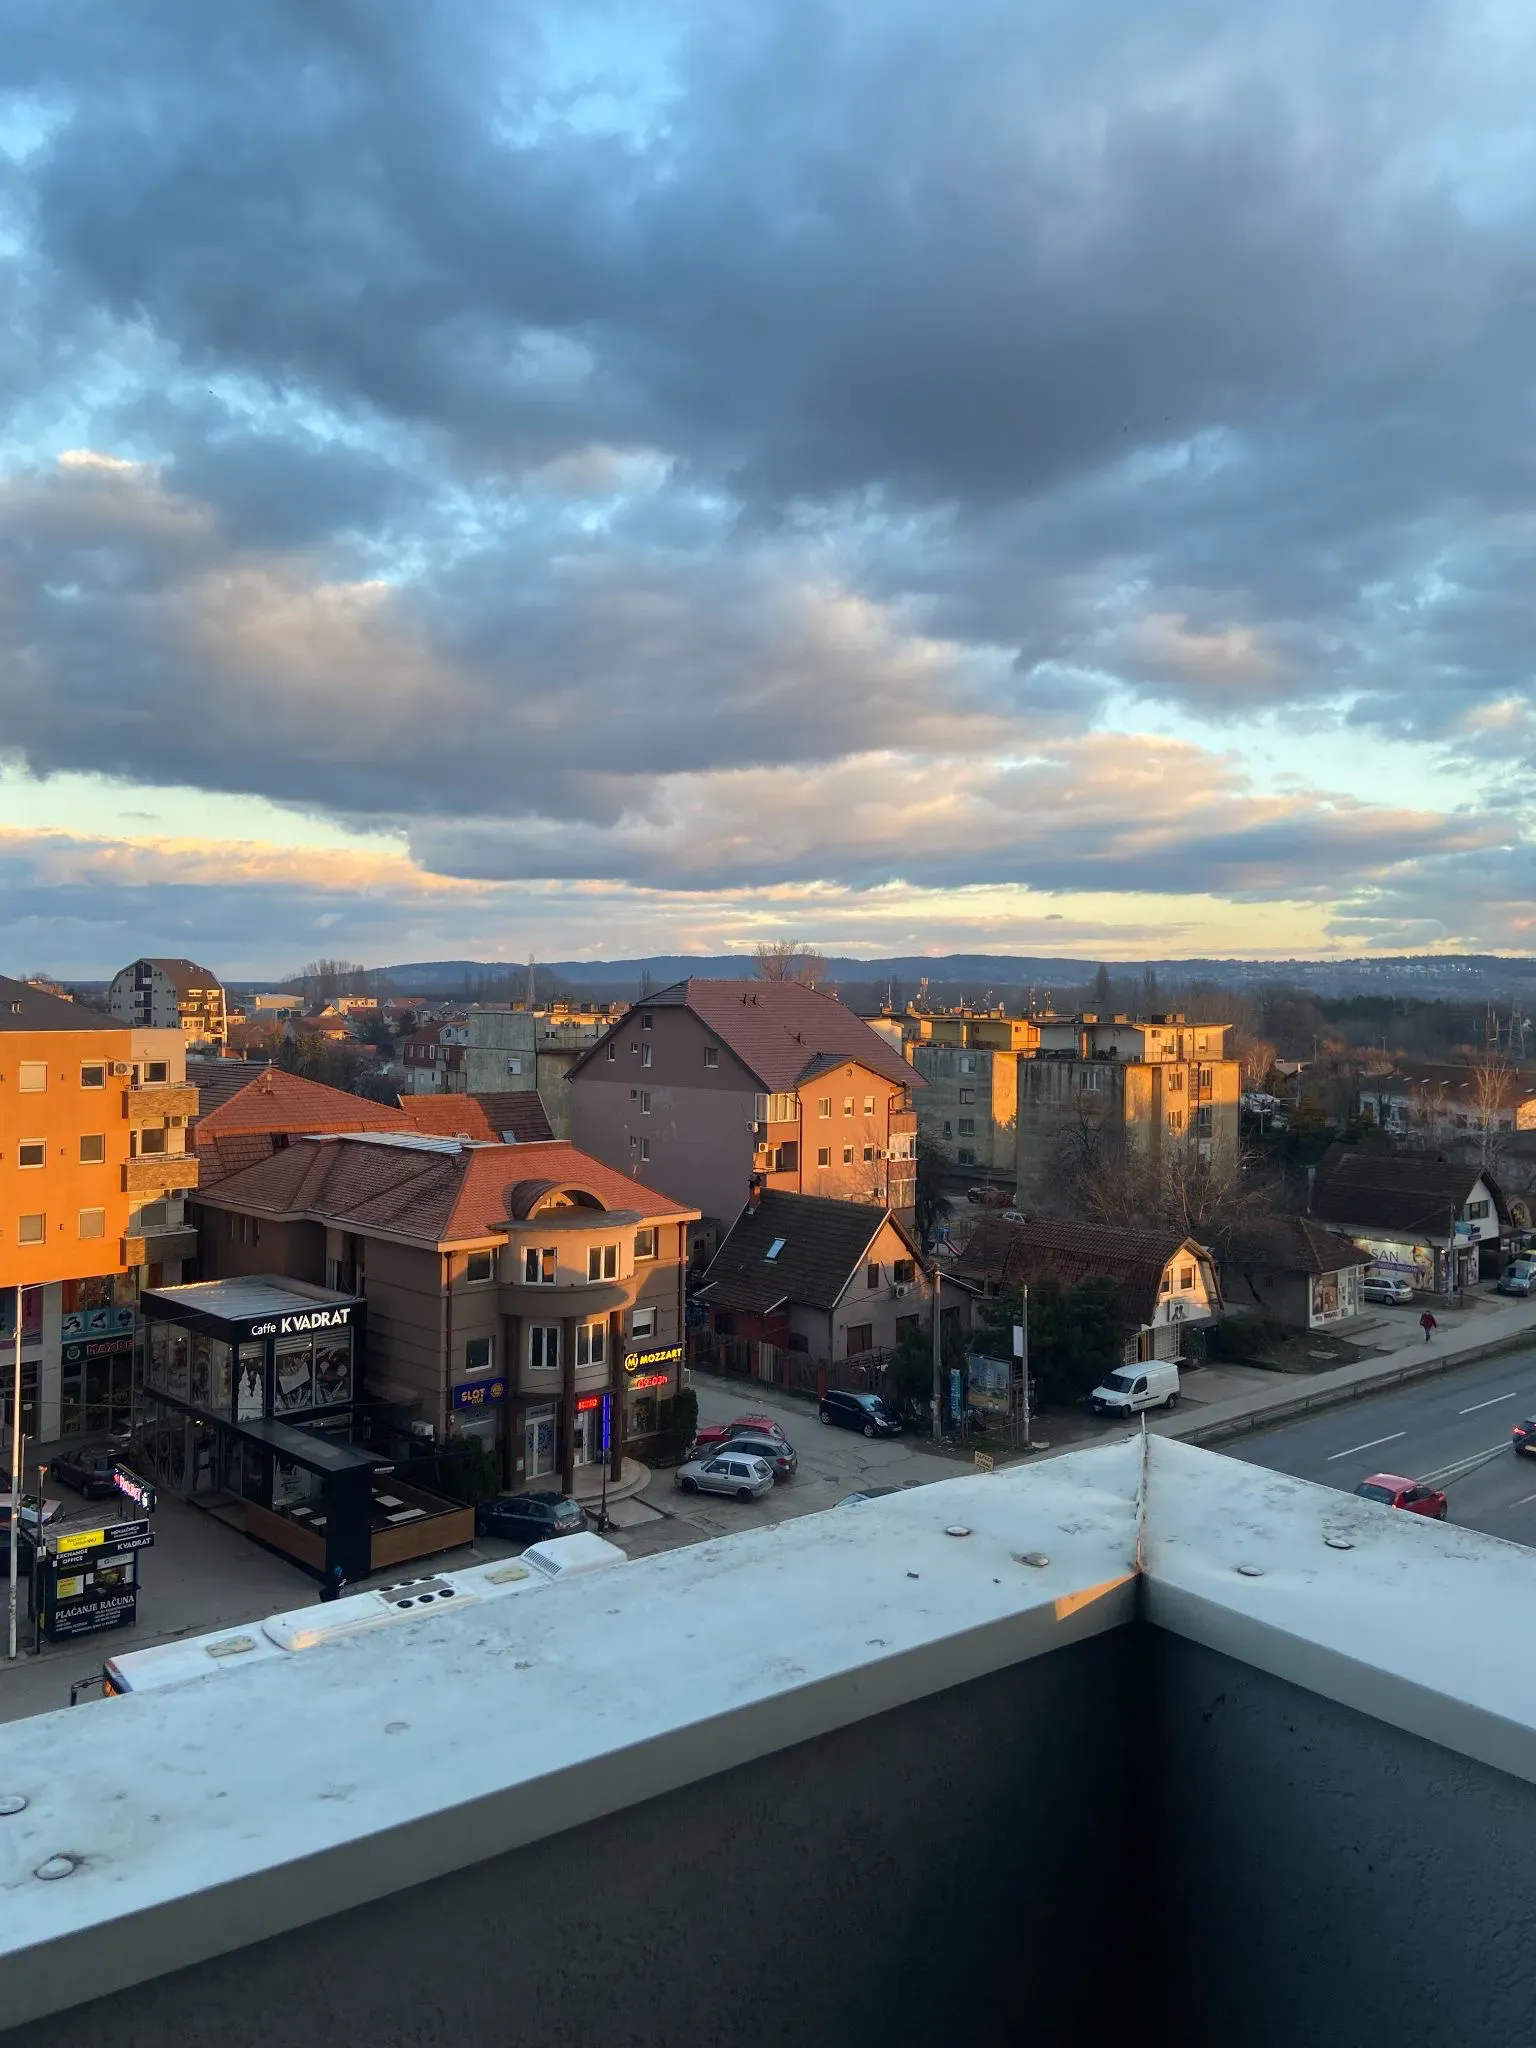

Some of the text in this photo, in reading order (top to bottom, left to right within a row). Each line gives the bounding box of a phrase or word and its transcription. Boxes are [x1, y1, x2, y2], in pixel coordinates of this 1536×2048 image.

[1371, 1248, 1399, 1262] SAN
[251, 1308, 351, 1336] Caffe KVADRAT
[639, 1348, 683, 1365] MOZZART
[461, 1388, 485, 1402] SLOT
[117, 1537, 152, 1551] KVADRAT
[56, 1548, 88, 1560] EXCHANGE
[62, 1555, 83, 1565] OFFICE
[55, 1603, 98, 1620] PLAĆANJE
[100, 1595, 135, 1609] RAČUNA
